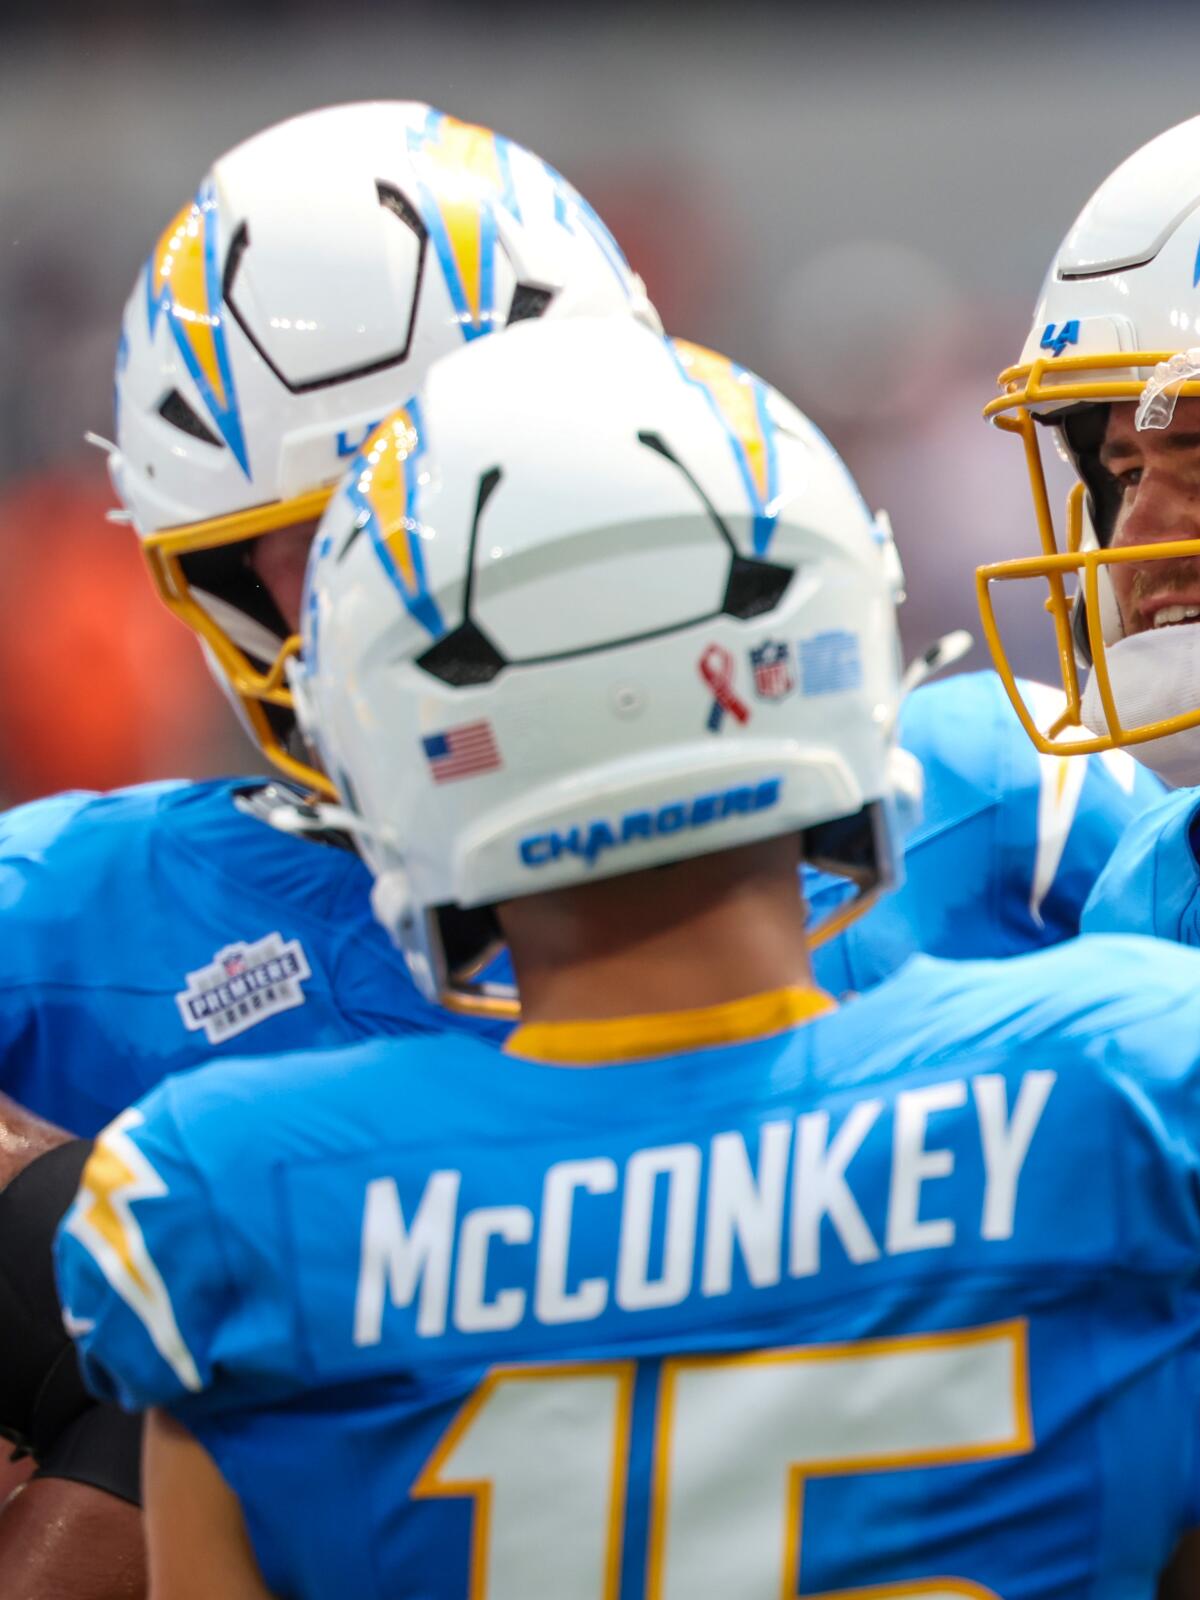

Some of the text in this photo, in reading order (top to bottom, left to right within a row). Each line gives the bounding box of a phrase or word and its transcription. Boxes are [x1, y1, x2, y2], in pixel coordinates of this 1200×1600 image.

[1040, 320, 1080, 357] LA
[519, 776, 781, 868] CHARGERS
[353, 1069, 1056, 1346] McCONKEY
